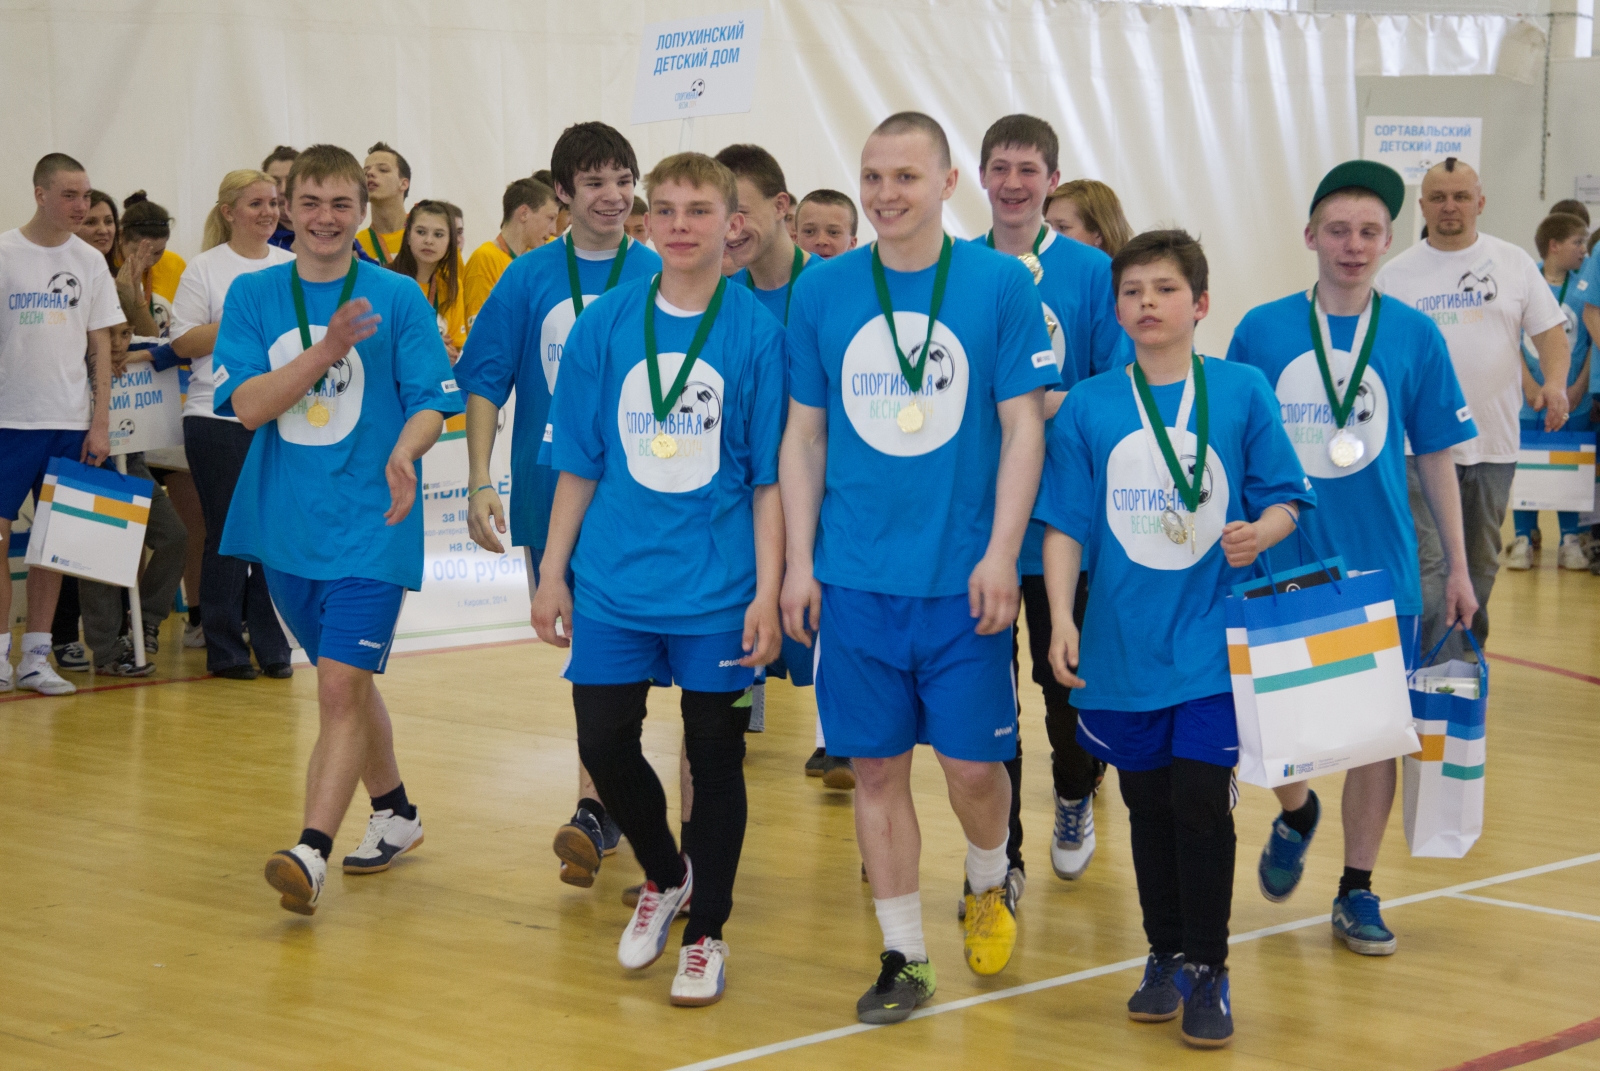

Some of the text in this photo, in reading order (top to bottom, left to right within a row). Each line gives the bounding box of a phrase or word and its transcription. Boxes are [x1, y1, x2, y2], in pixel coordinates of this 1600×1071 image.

[655, 20, 745, 51] ЛОПУХИНСКИЙ
[653, 47, 741, 76] ДЕТСКИЙ ДОМ
[1374, 124, 1472, 138] СОРТАВАЛЬСКИЙ
[1379, 139, 1462, 154] ДЕТСКИЙ ДОМ
[8, 292, 69, 311] СПОРТИВНАЯ
[1415, 290, 1483, 313] СПОРТИВНАЯ
[19, 310, 45, 326] ВЕСНА
[111, 367, 153, 390] РСКИЙ
[134, 389, 164, 410] ДОМ
[1130, 515, 1163, 535] ВЕСНА
[449, 543, 463, 552] на
